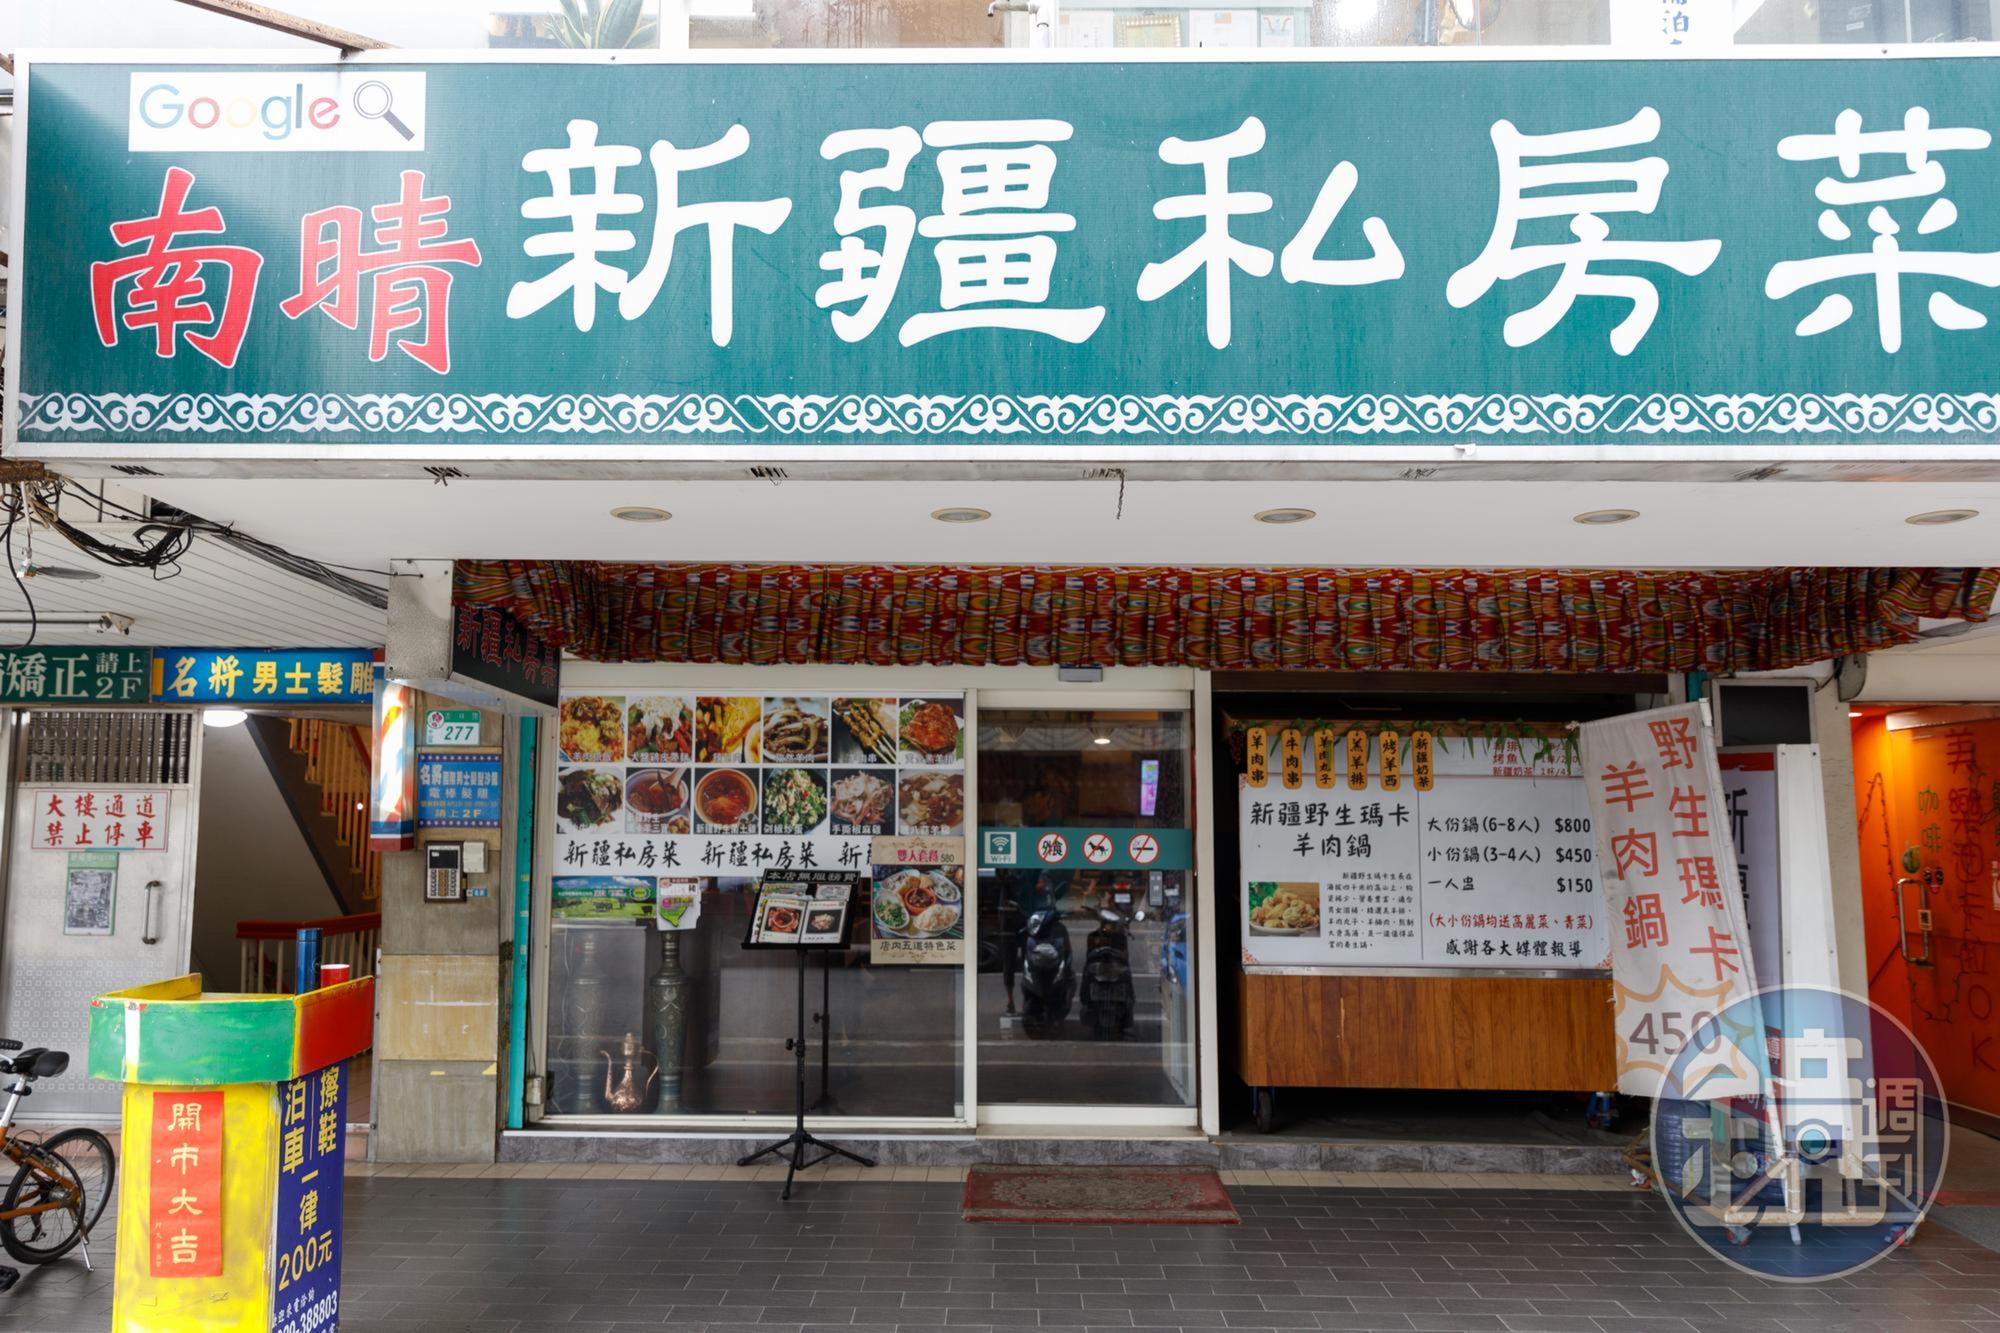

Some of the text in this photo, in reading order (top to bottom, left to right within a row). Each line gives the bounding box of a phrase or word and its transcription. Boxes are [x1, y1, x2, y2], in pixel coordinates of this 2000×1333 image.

[139, 82, 342, 141] Google
[506, 106, 2000, 355] 新疆私房菜
[90, 165, 482, 375] 南晴
[0, 652, 90, 699] 矯正
[95, 652, 143, 675] 請上
[96, 677, 142, 699] 2F
[444, 726, 475, 742] 277
[1251, 735, 1265, 783] 羊肉串
[1286, 737, 1300, 785] 牛肉串
[46, 792, 157, 819] 大樓通道
[1250, 801, 1410, 828] 新疆野生瑪卡
[44, 820, 155, 848] 禁止停車
[1555, 817, 1591, 833] $800
[564, 839, 682, 870] 新疆私房菜
[701, 839, 818, 869] 新疆私房菜
[941, 853, 955, 863] 580
[1293, 832, 1372, 858] 羊肉鍋
[1555, 847, 1592, 863] $450
[1601, 760, 1670, 949] 羊肉鍋
[1648, 716, 1740, 982] 野生瑪卡
[1556, 877, 1593, 893] $150
[1445, 939, 1583, 958] 感謝各大媒體報導
[1629, 1010, 1722, 1055] 450
[282, 1080, 307, 1175] 泊車
[317, 1066, 341, 1156] 擦鞋
[167, 1102, 203, 1265] 開市大吉
[299, 1169, 320, 1236] 一律
[278, 1229, 333, 1292] 200元
